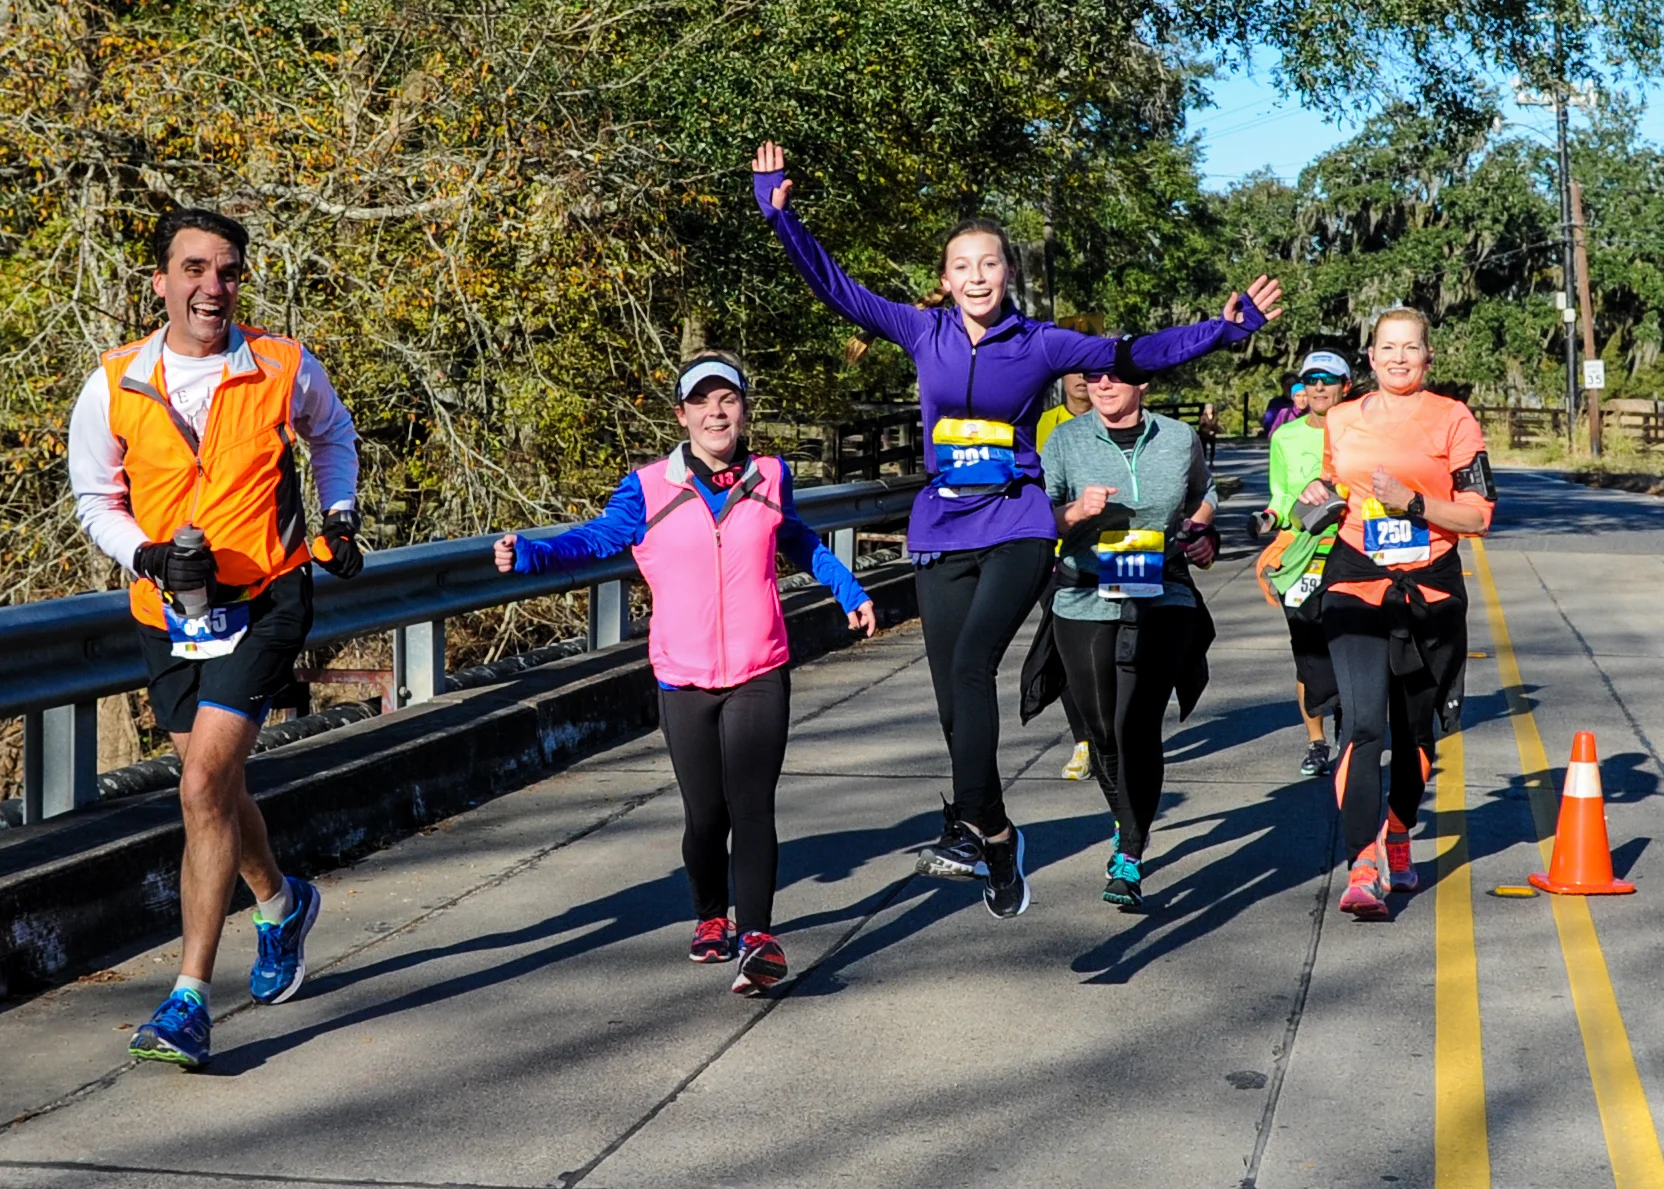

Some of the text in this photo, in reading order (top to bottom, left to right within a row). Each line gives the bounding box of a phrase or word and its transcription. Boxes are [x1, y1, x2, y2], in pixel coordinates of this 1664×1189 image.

[1587, 374, 1603, 385] 35
[1377, 519, 1413, 546] 250
[1115, 554, 1146, 578] 111
